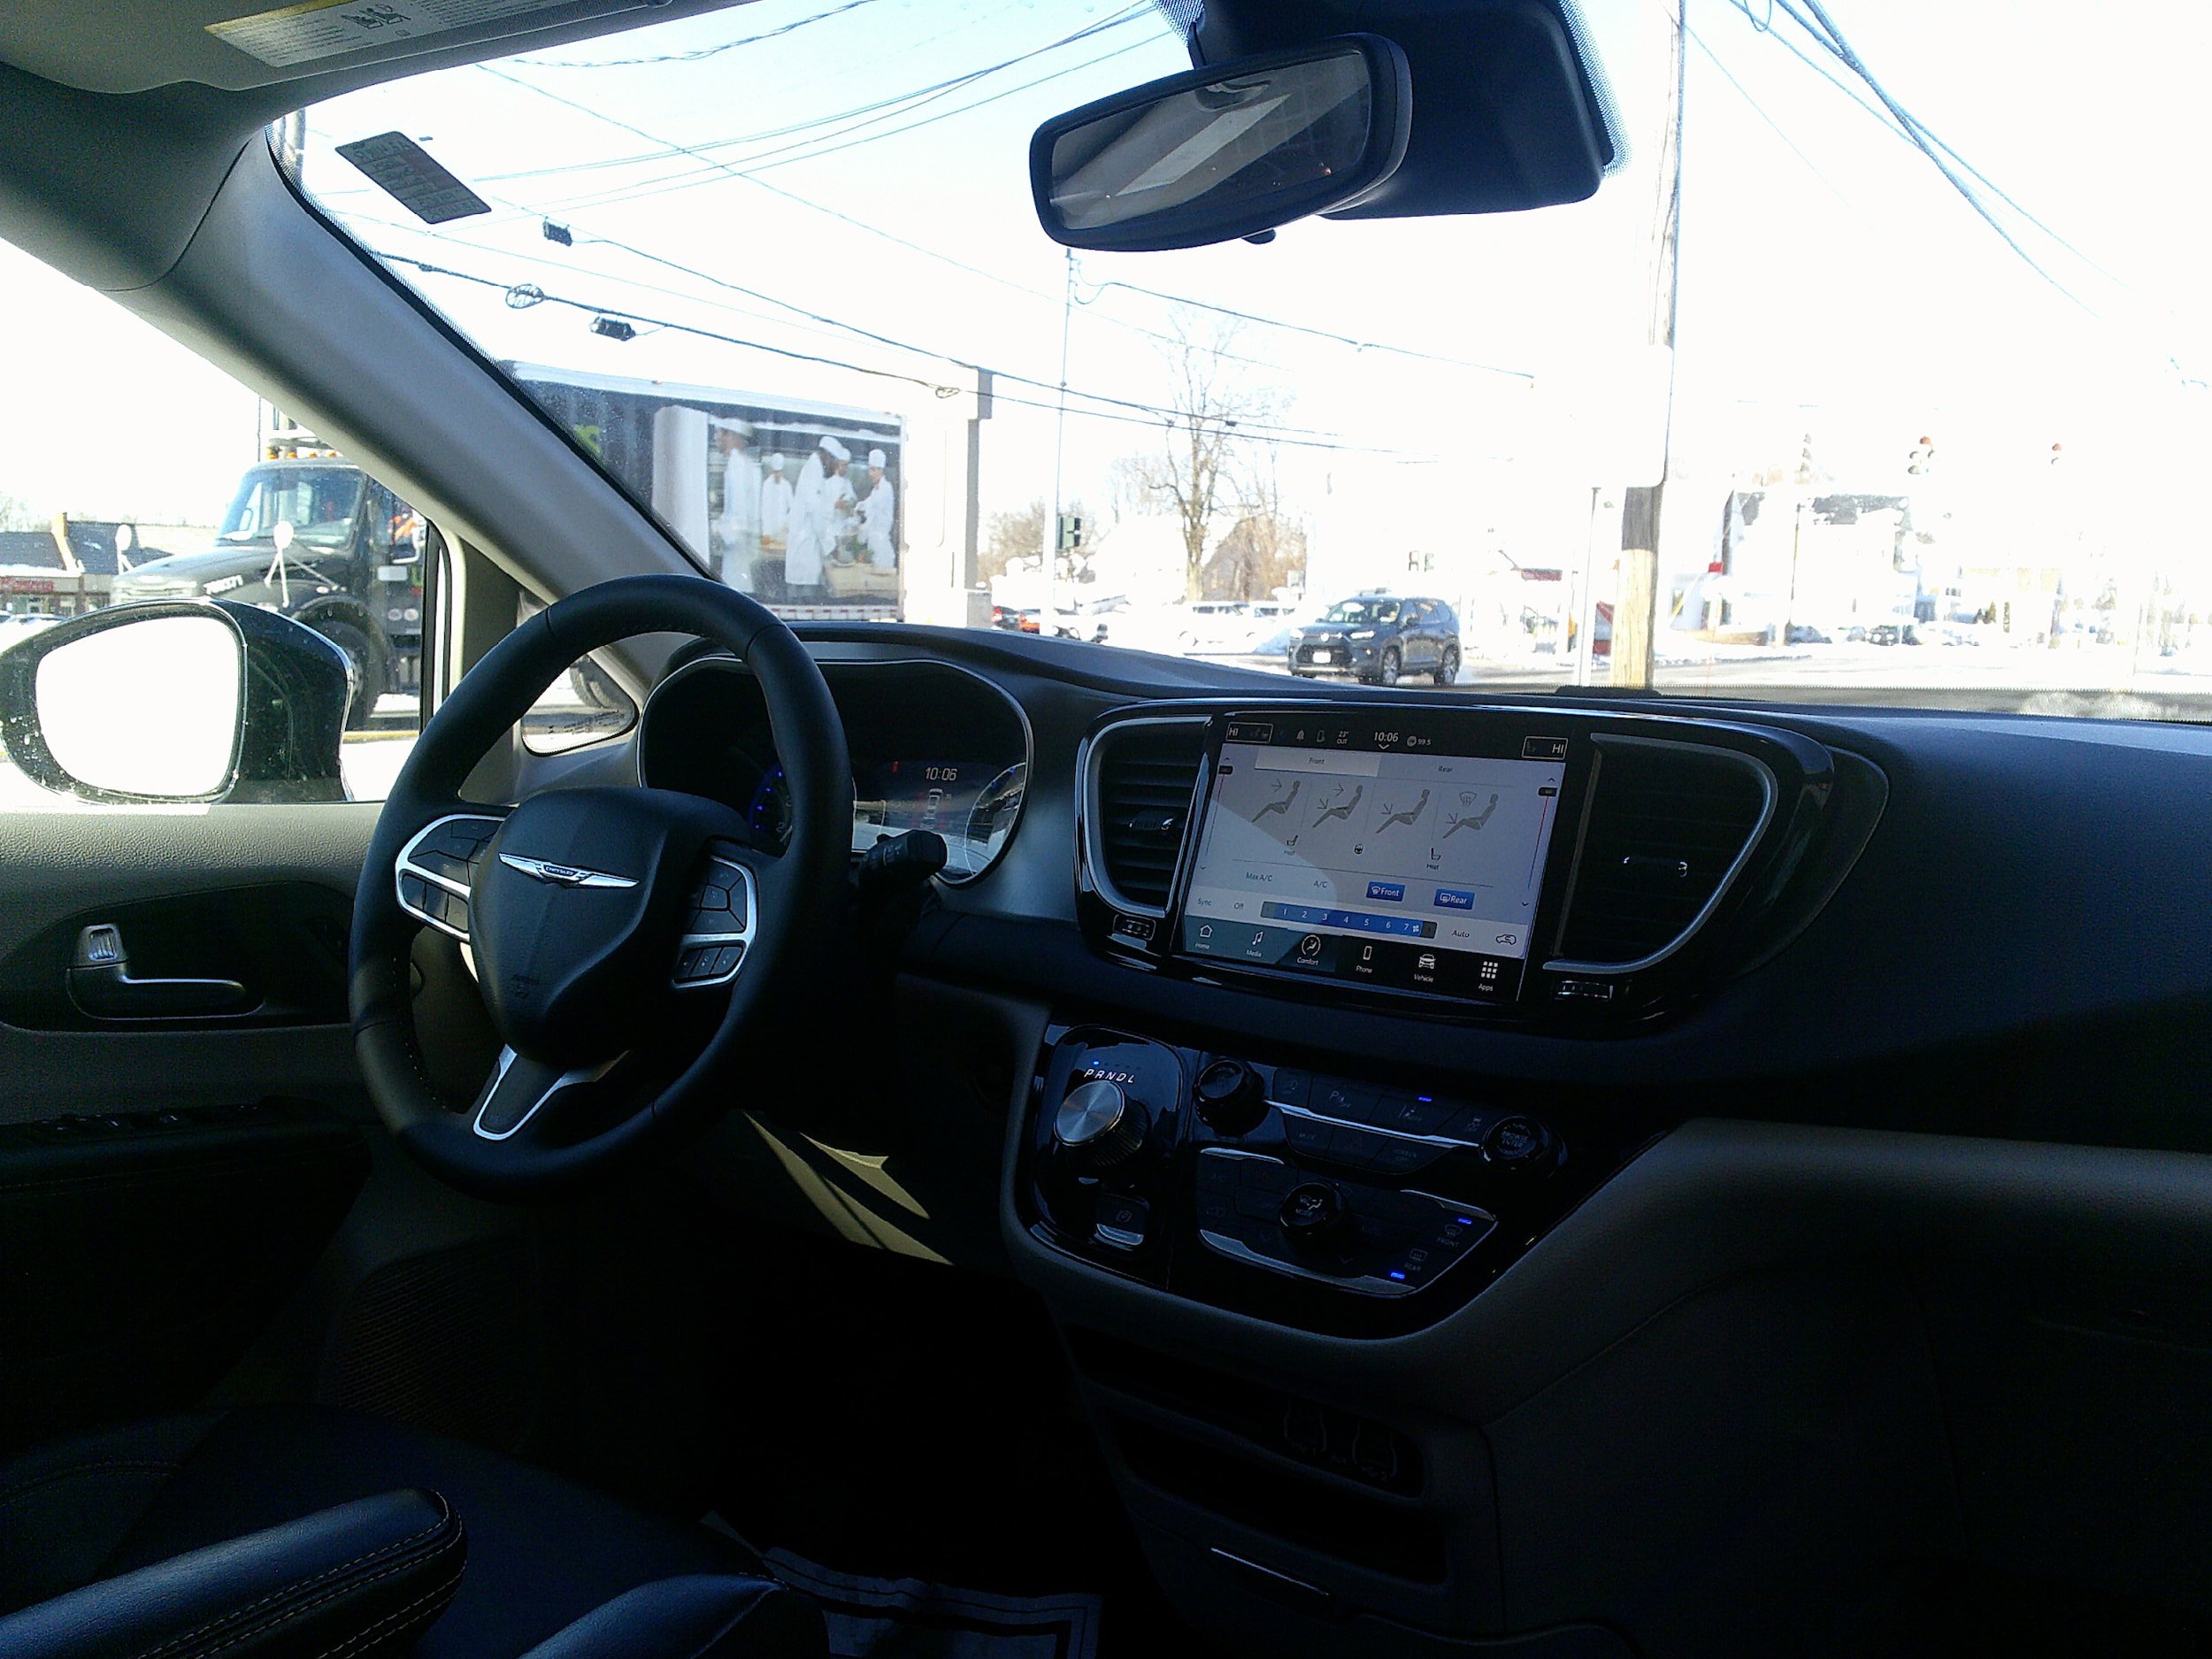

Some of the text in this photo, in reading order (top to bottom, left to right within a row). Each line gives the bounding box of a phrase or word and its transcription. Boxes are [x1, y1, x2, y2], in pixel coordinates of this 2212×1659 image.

[1373, 732, 1399, 742] 10:06
[1551, 743, 1564, 754] HI
[925, 767, 958, 781] 10:06
[1380, 887, 1400, 897] Front
[1246, 949, 1262, 957] Media
[1297, 956, 1319, 965] Comfort
[1414, 973, 1433, 983] Vehicle
[1478, 983, 1494, 992] Apps
